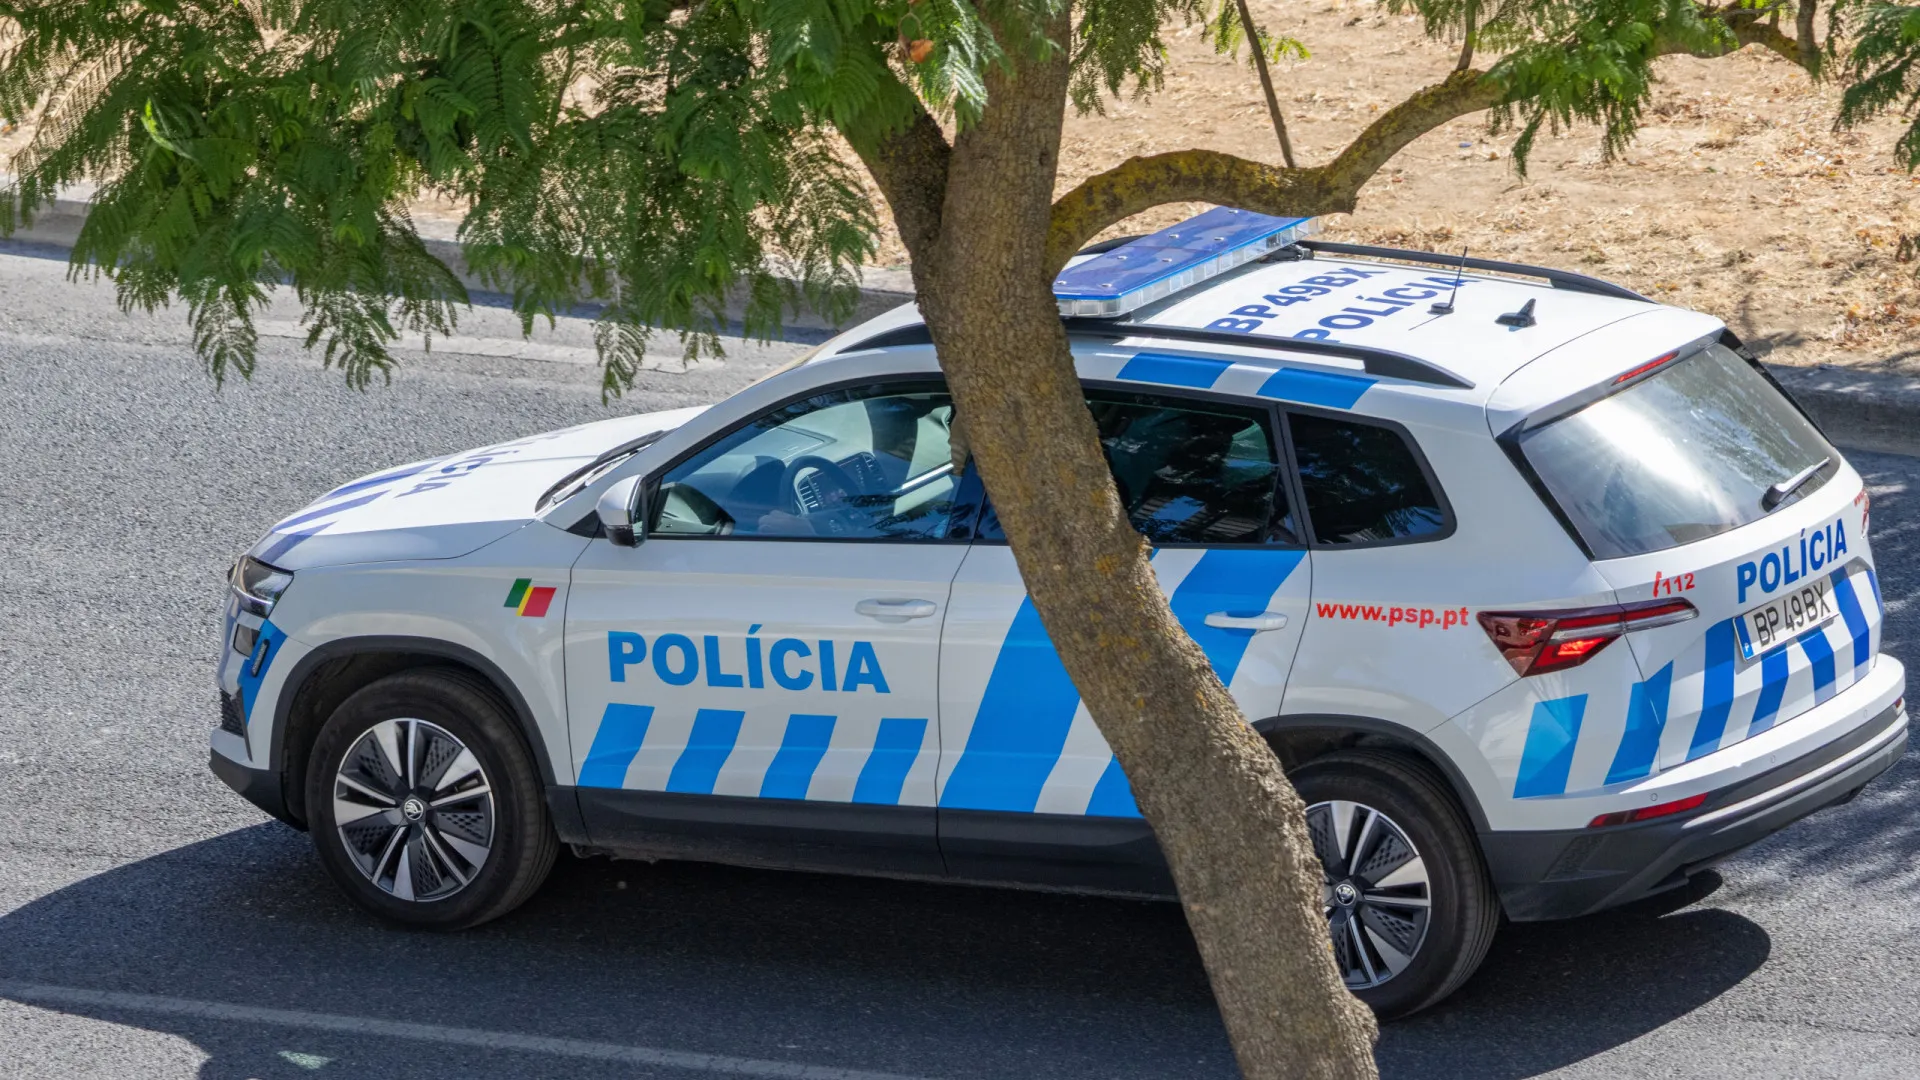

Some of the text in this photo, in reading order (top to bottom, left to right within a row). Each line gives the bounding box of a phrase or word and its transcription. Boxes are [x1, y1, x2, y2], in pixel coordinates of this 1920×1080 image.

[1203, 267, 1390, 334] BP49BX
[1293, 275, 1483, 344] POLÍCIA
[1662, 572, 1695, 595] 112
[1736, 518, 1848, 604] POLÍCIA
[1316, 602, 1469, 630] www.psp.pt
[607, 623, 891, 694] POLÍCIA
